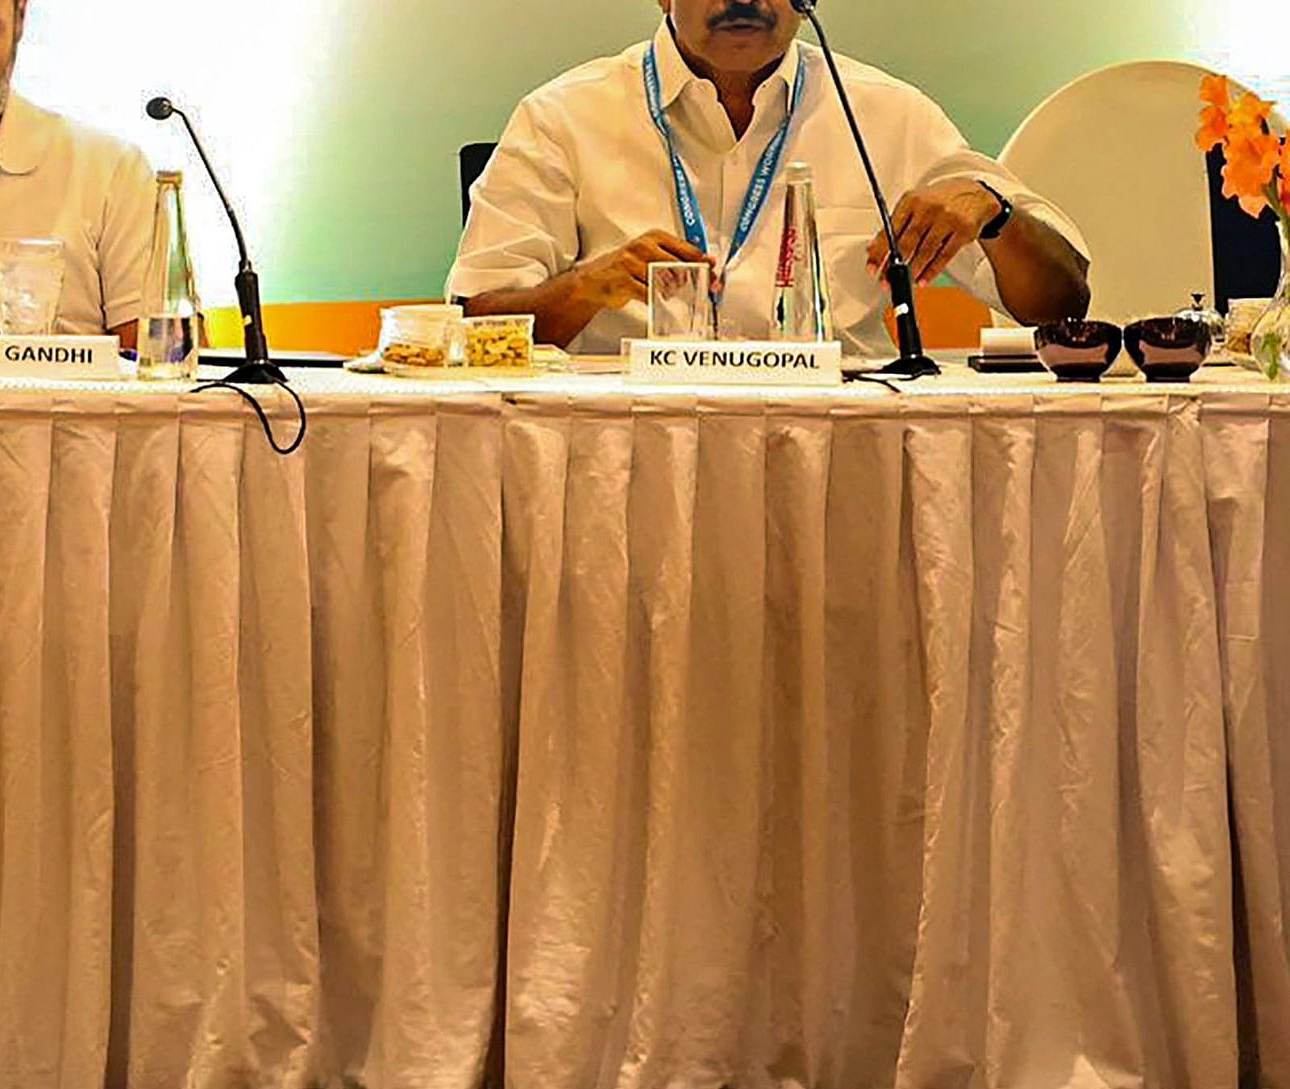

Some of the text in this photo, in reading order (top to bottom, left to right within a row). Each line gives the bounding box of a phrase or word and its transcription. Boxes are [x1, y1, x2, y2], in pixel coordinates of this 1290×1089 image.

[4, 345, 93, 363] GANDHI
[650, 350, 820, 368] KC VENUGOPAL
